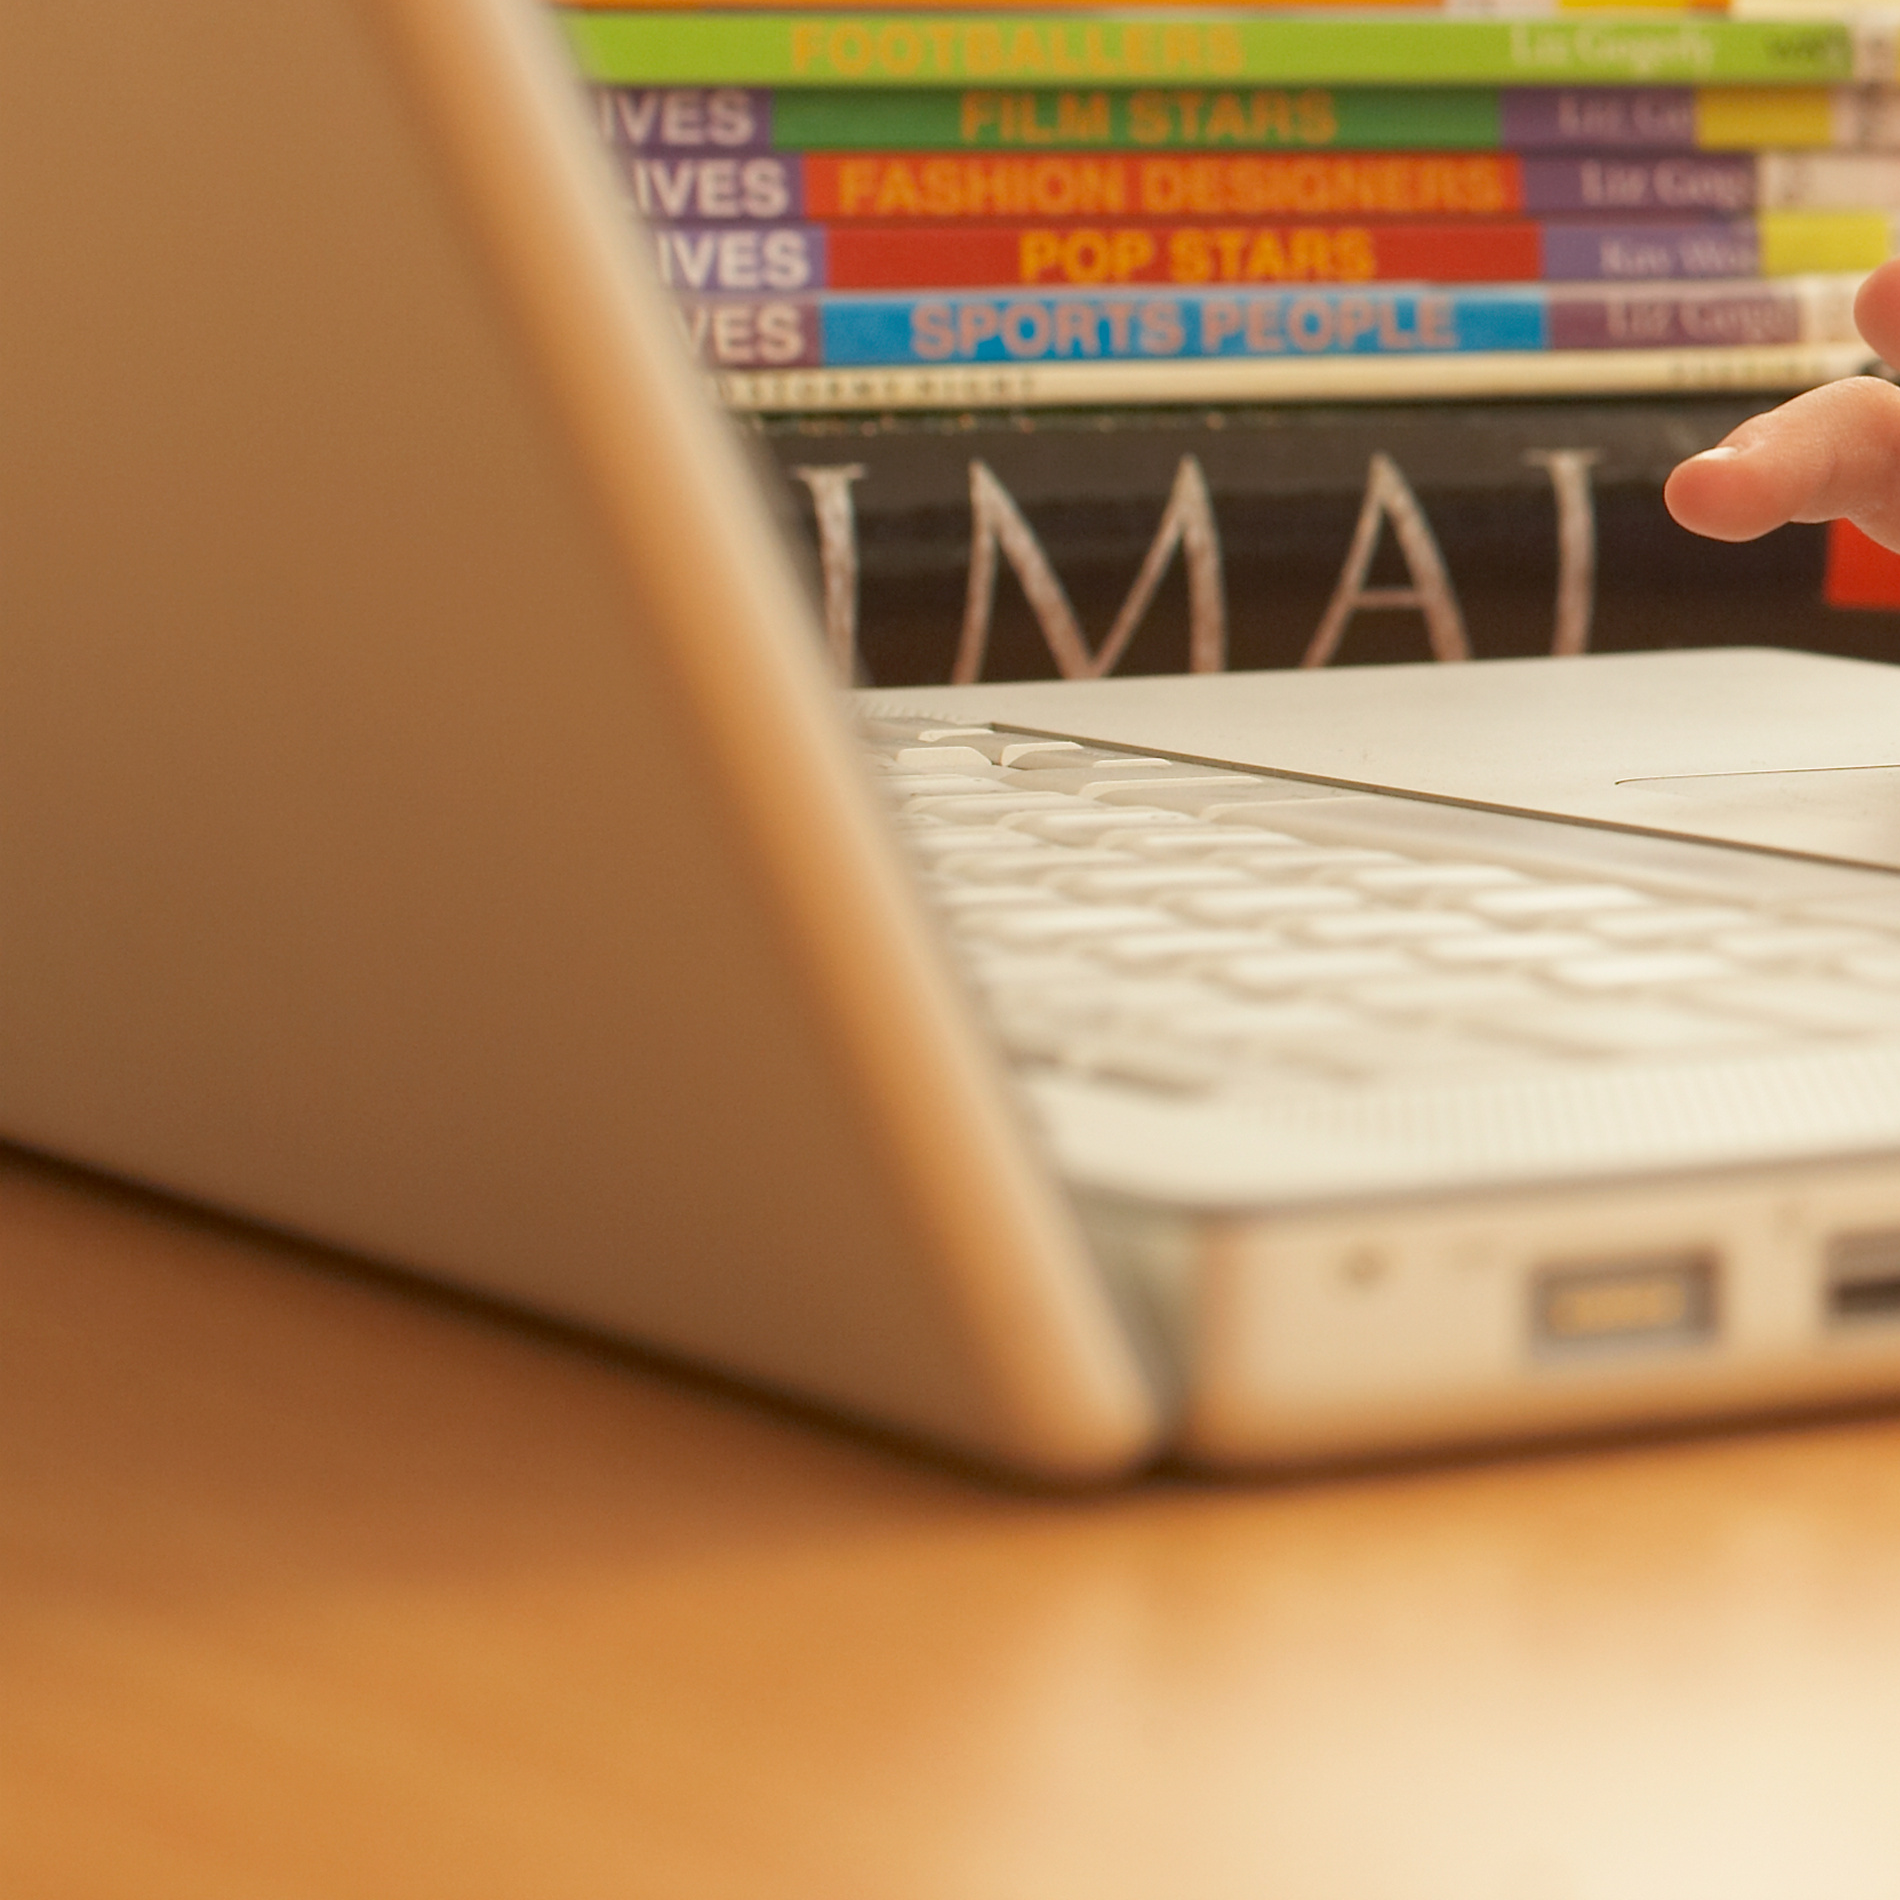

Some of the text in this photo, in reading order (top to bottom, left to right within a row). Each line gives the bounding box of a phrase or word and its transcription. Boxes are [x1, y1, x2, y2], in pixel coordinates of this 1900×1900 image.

[790, 21, 1245, 78] FOOTBALLERS
[1508, 20, 1568, 67] Liz
[961, 91, 1111, 144] FILM
[1127, 90, 1339, 145] STARS
[1557, 96, 1615, 138] Liz
[632, 157, 791, 220] IVES
[838, 157, 1125, 217] FASHION
[1141, 156, 1504, 216] DESIGNERS
[1580, 158, 1648, 203] Liz
[655, 227, 812, 290] IVES
[1018, 227, 1157, 286] POP
[1167, 227, 1379, 285] STARS
[909, 299, 1185, 361] SPORTS
[1202, 295, 1461, 355] PEOPLE
[1605, 293, 1673, 341] Liz
